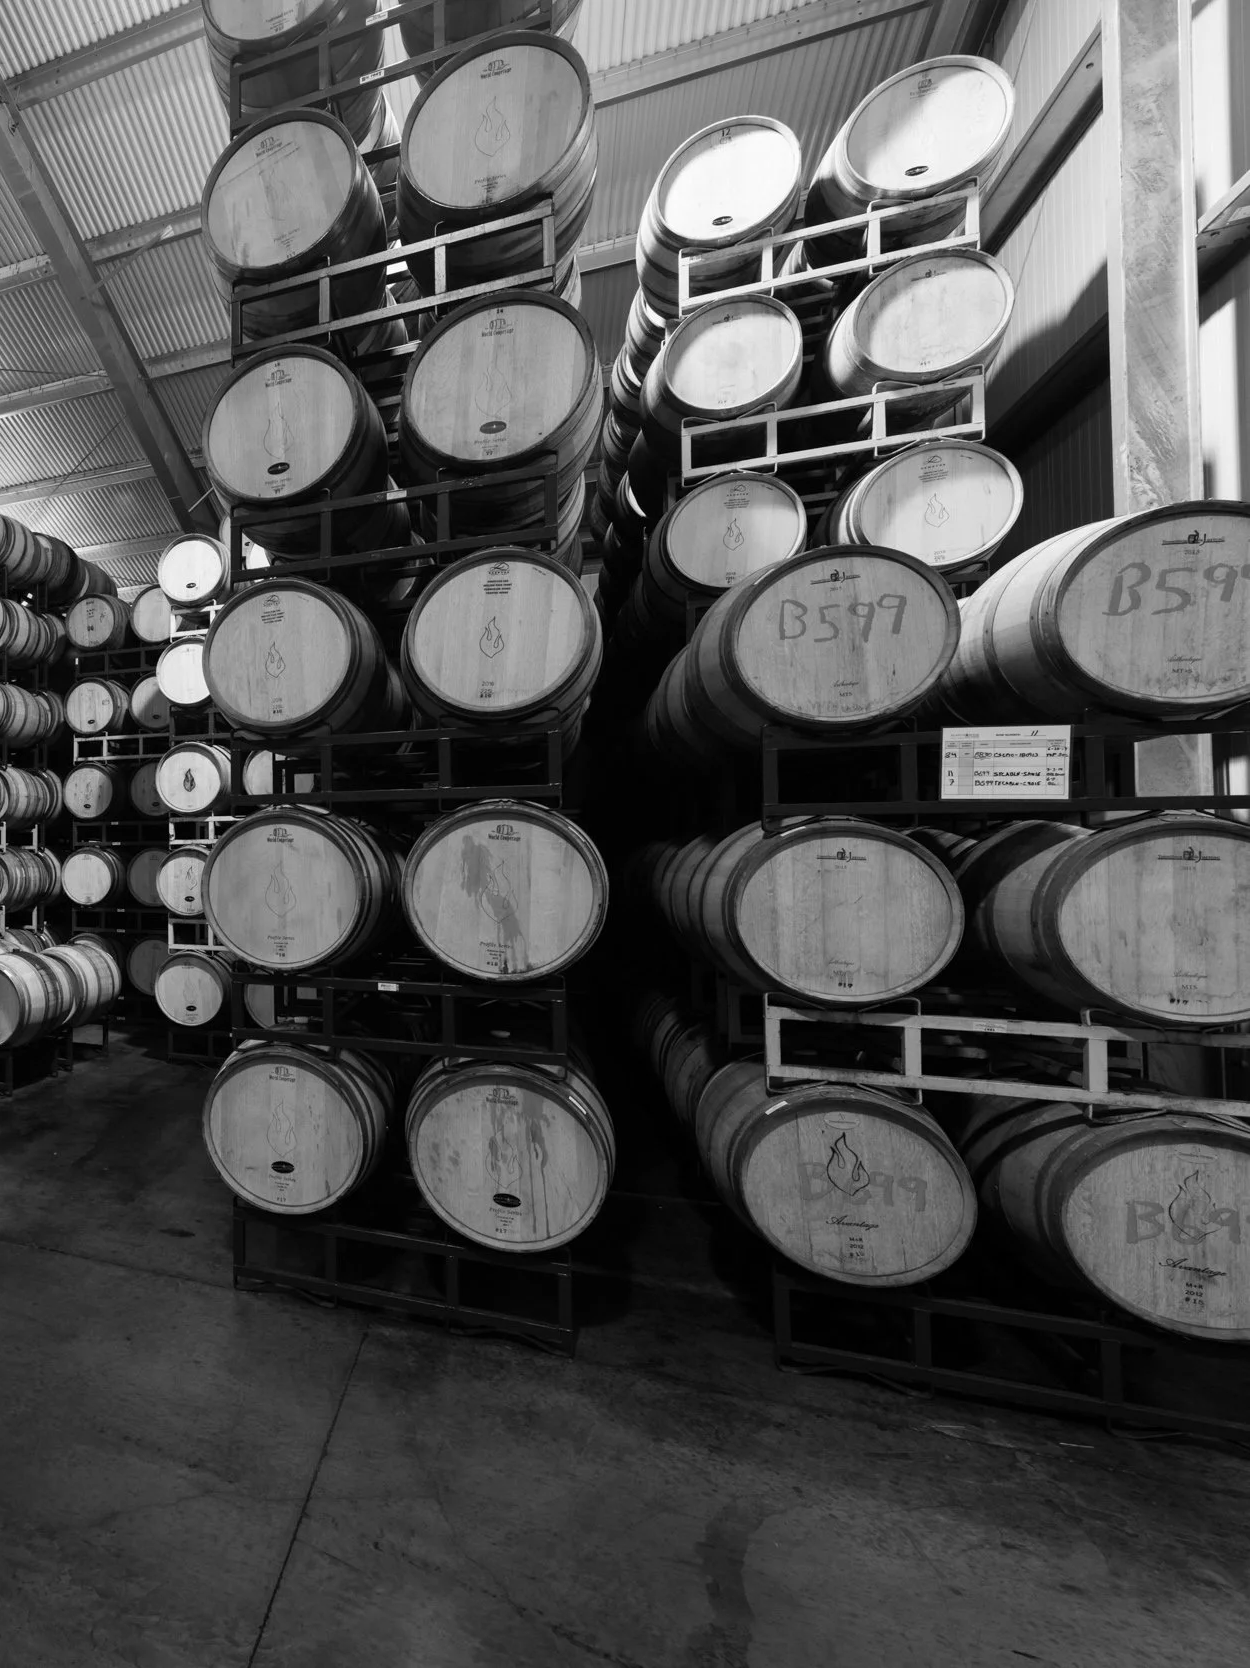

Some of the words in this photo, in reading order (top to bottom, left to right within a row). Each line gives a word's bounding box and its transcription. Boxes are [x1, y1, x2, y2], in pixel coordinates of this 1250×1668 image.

[779, 594, 907, 643] B599
[1126, 1201, 1250, 1245] B69
[1184, 1289, 1205, 1298] 2012
